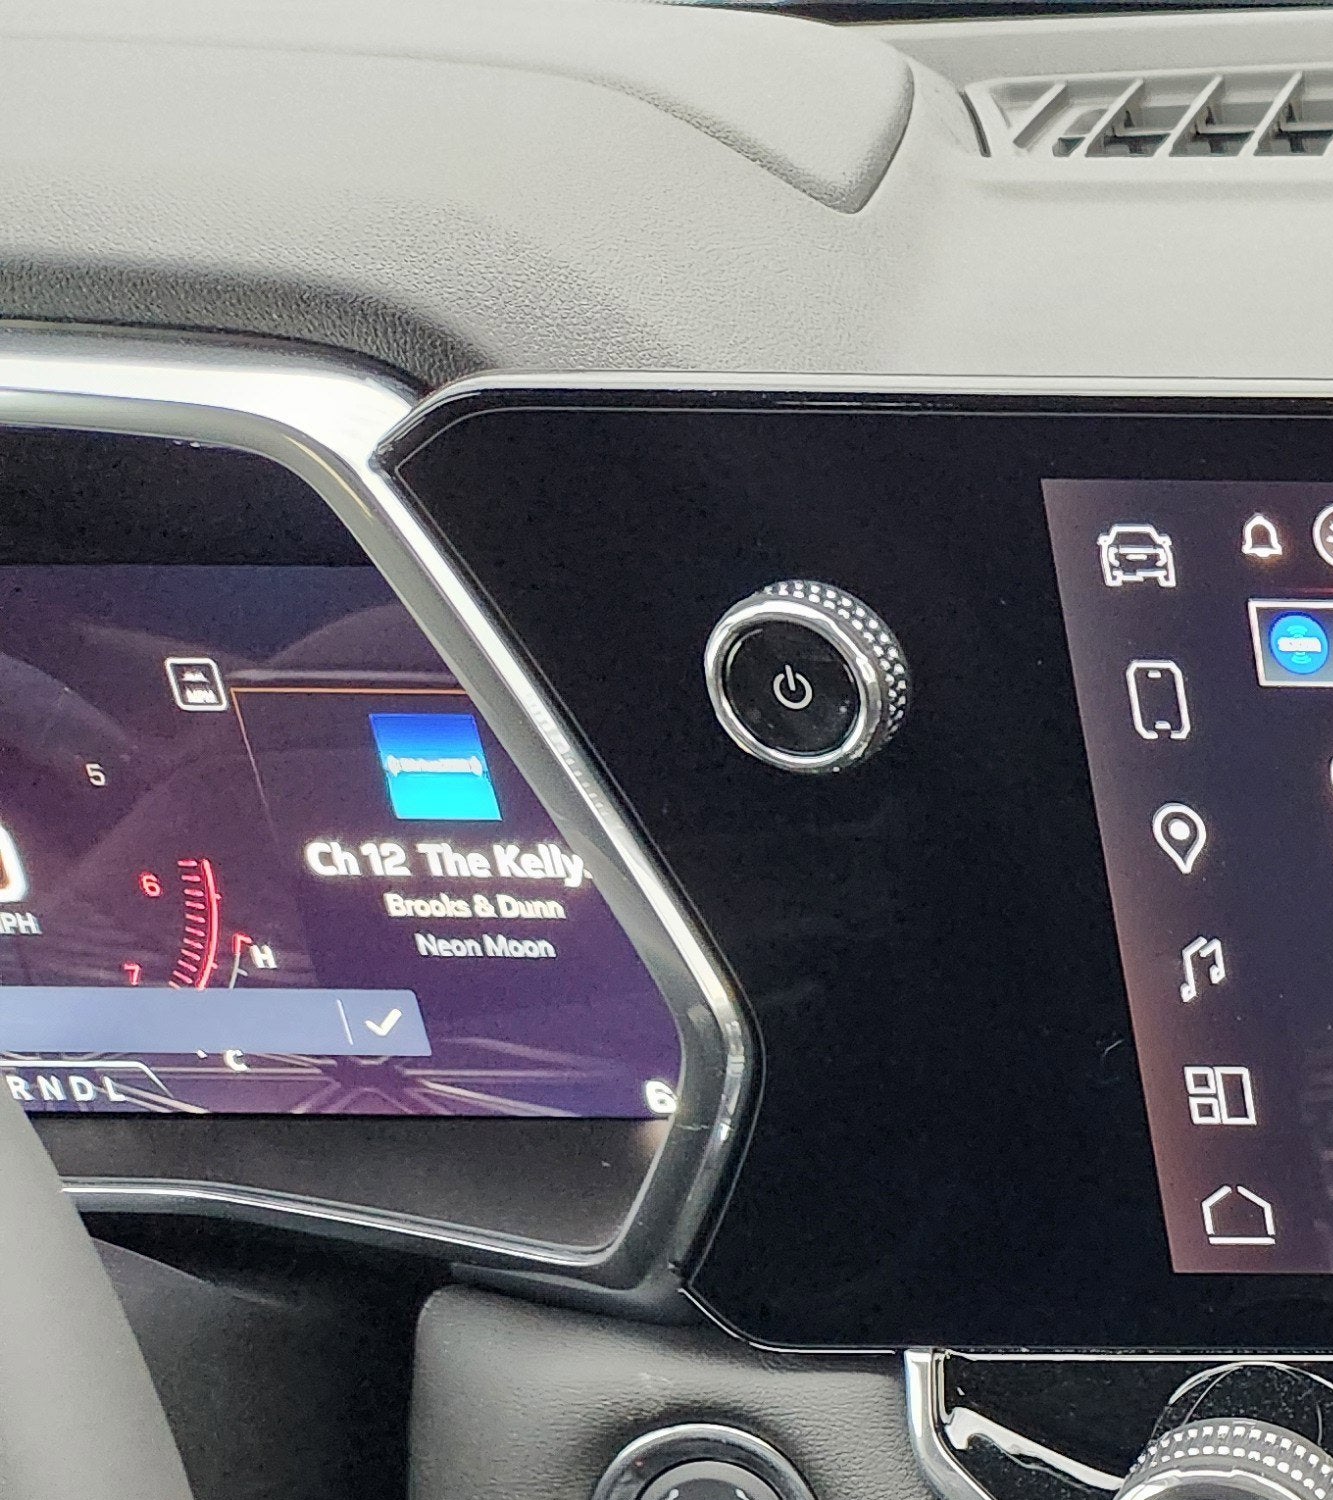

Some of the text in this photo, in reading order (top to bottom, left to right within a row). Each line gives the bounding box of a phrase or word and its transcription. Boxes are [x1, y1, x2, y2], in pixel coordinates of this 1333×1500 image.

[84, 763, 107, 786] 5
[305, 842, 361, 876] Ch
[360, 842, 411, 877] 12
[415, 842, 492, 878] The
[139, 871, 163, 897] 6
[383, 892, 567, 919] Brooks & Dunn
[249, 944, 276, 969] H
[414, 932, 557, 958] Neon Moon
[122, 962, 142, 987] 7
